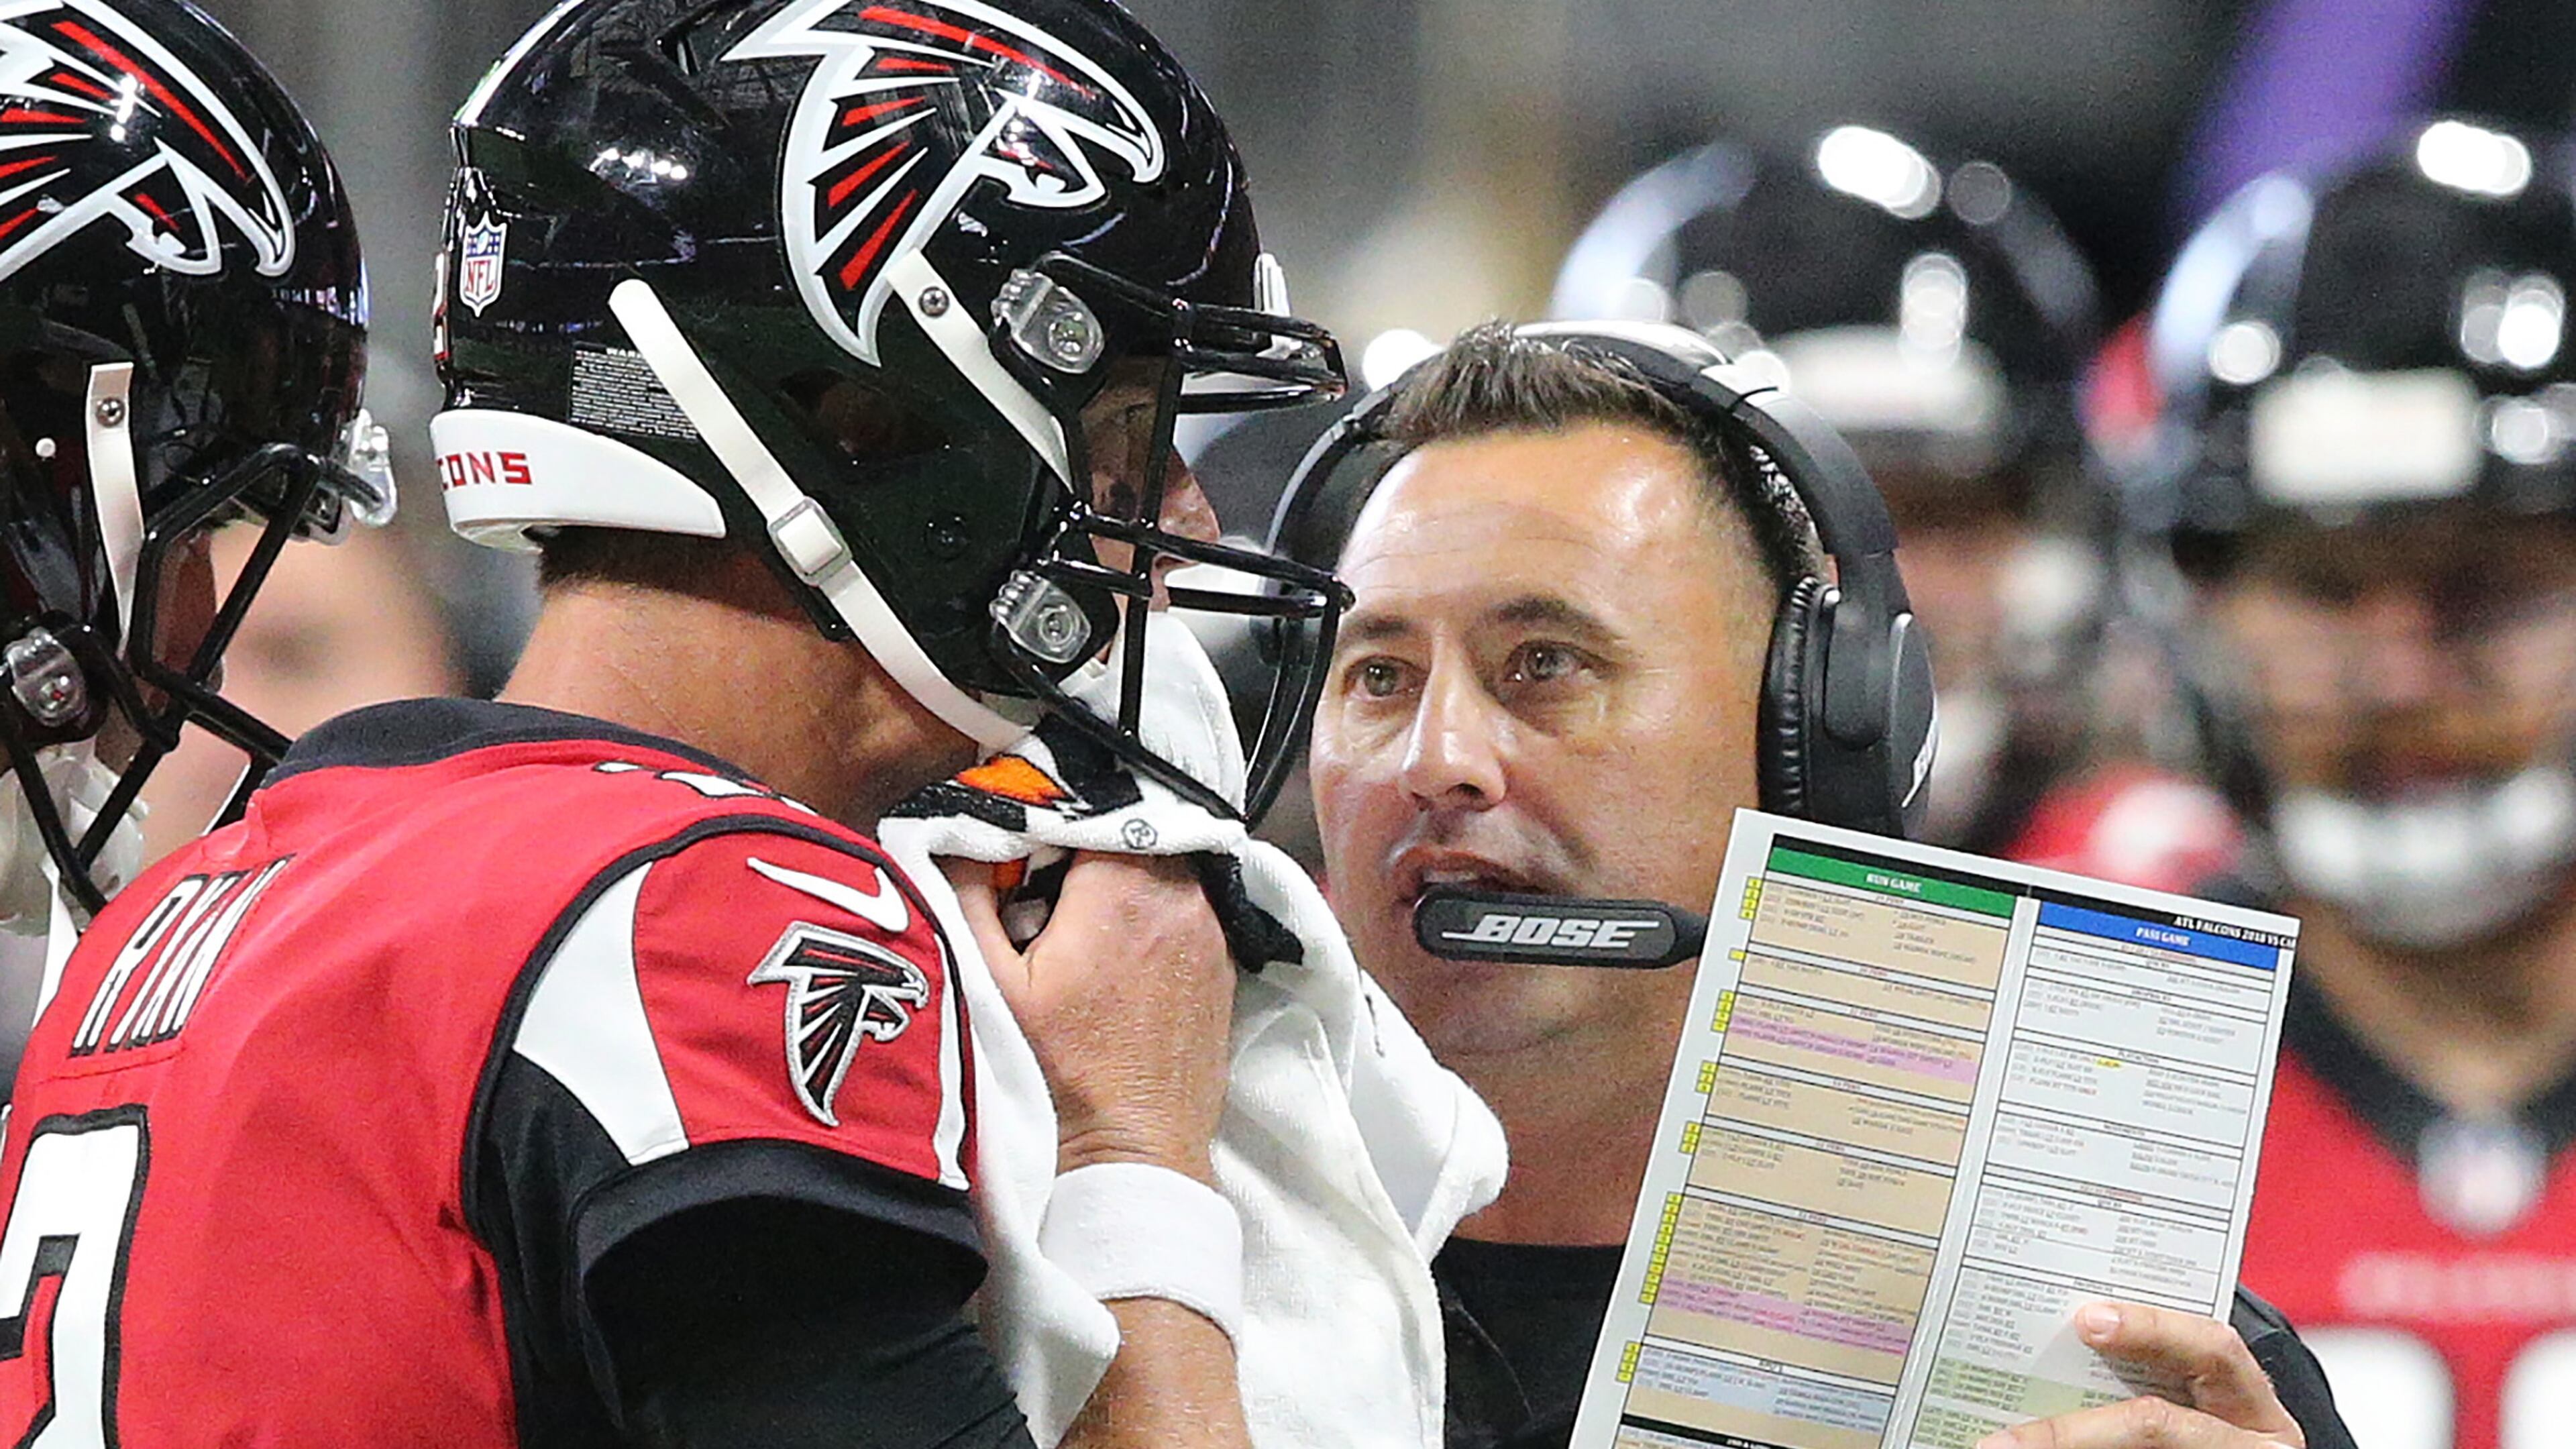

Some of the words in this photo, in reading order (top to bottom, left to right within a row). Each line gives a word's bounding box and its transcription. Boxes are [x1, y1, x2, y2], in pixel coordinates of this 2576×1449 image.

[466, 260, 494, 297] NFL
[1866, 873, 1890, 887] RUN
[1890, 875, 1923, 893] GAME
[1442, 914, 1660, 949] BOSE
[2161, 930, 2191, 947] GAME
[2196, 920, 2241, 938] FALCONS
[67, 853, 296, 1058] RYAN
